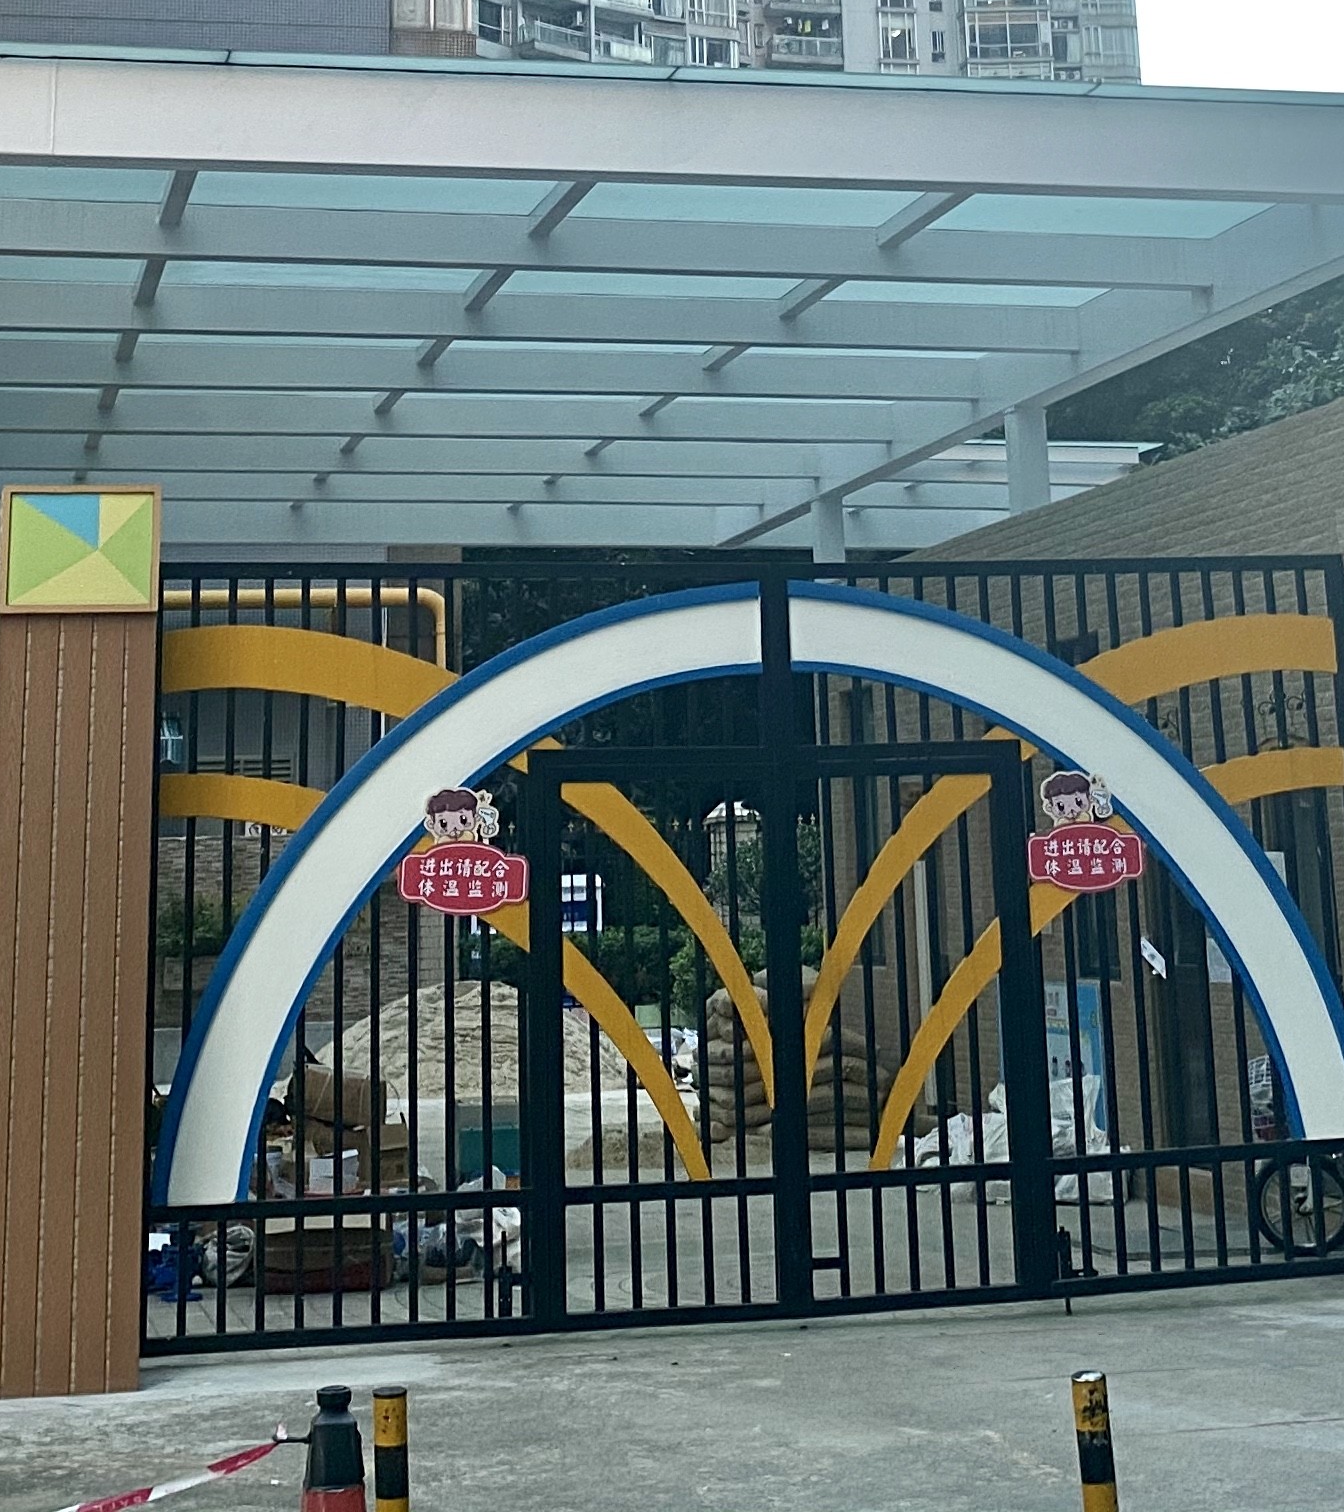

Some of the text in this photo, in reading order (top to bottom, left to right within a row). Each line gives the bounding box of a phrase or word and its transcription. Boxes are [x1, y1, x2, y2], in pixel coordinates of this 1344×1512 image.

[1043, 838, 1125, 857] 进出请配合
[419, 858, 510, 878] 进出请配合
[1044, 857, 1127, 877] 体温监测
[418, 878, 509, 899] 体温监测
